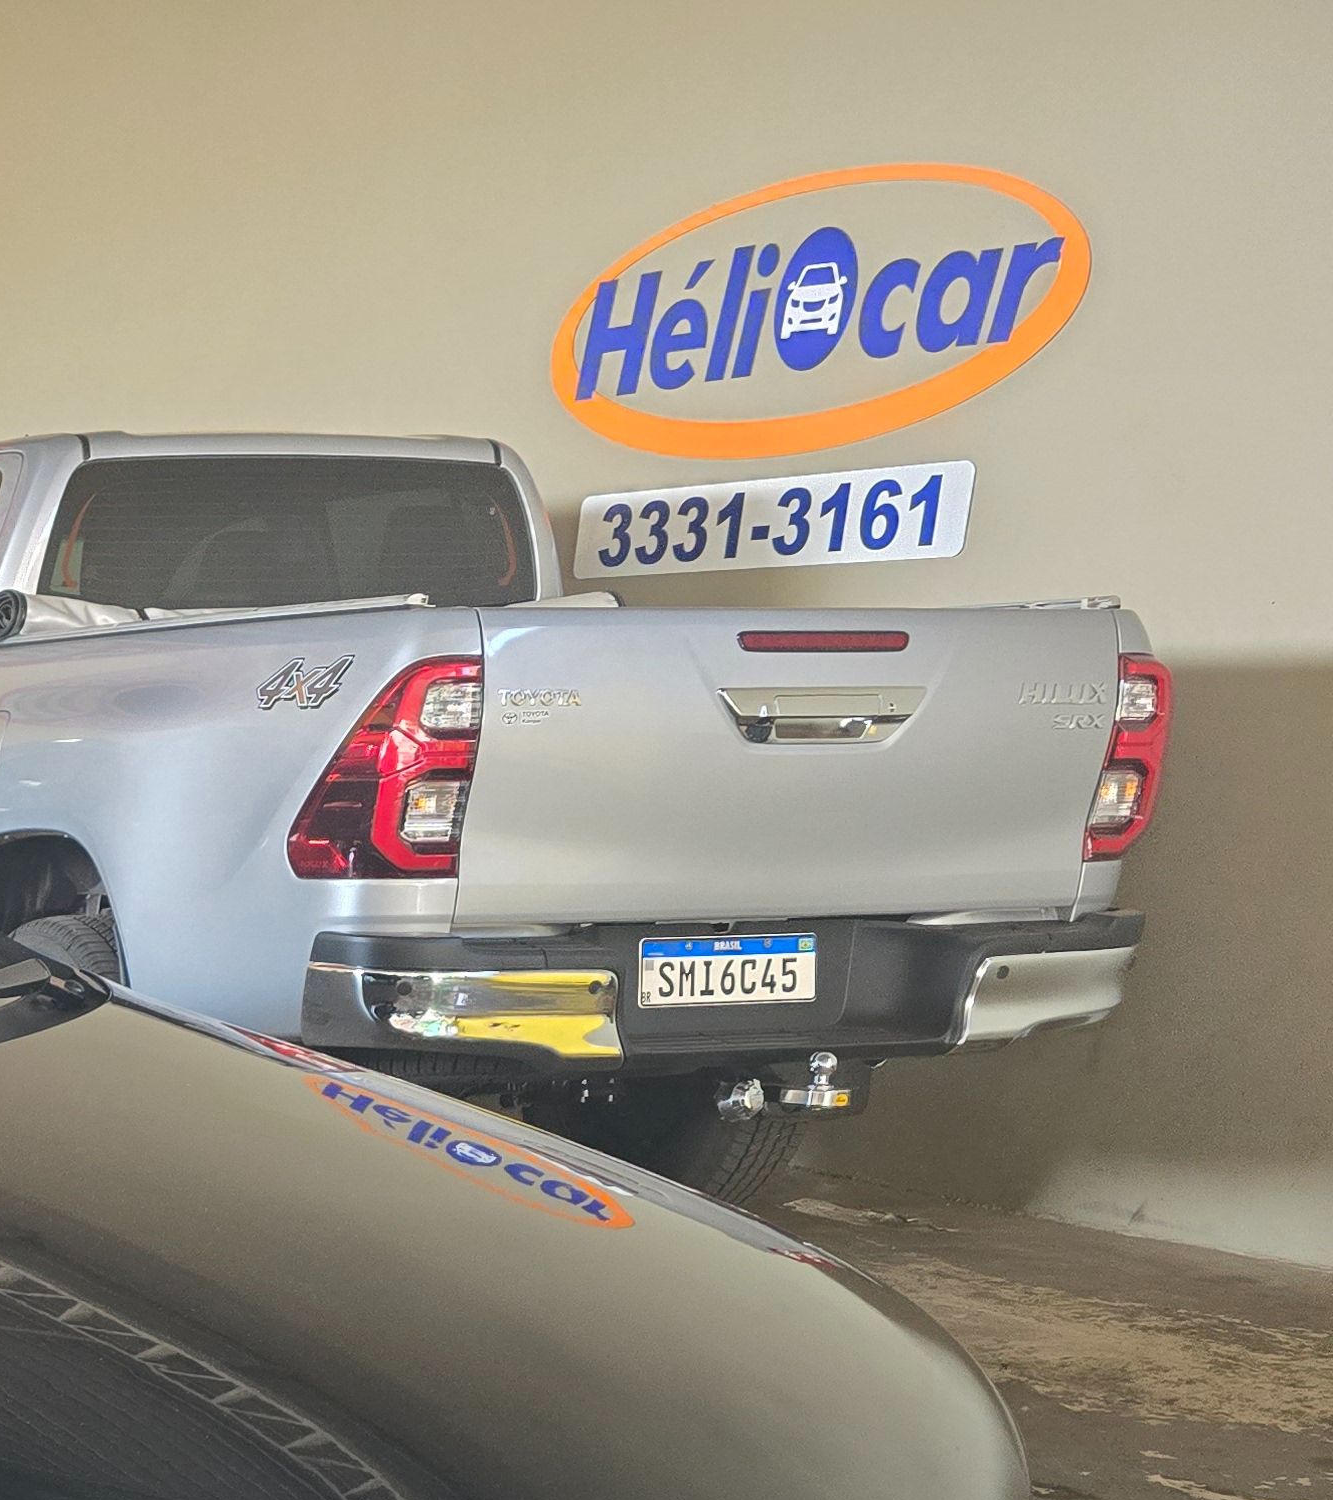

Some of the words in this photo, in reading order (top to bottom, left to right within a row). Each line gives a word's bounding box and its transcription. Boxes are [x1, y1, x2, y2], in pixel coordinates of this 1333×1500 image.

[598, 475, 944, 568] 3331-3161
[256, 654, 355, 709] 4x4
[497, 688, 582, 707] TOYOTA
[1018, 681, 1107, 705] HILUX
[1052, 713, 1105, 730] SRX
[713, 941, 742, 951] BRASIL
[658, 958, 797, 998] SMI6C45
[641, 991, 651, 1004] BR
